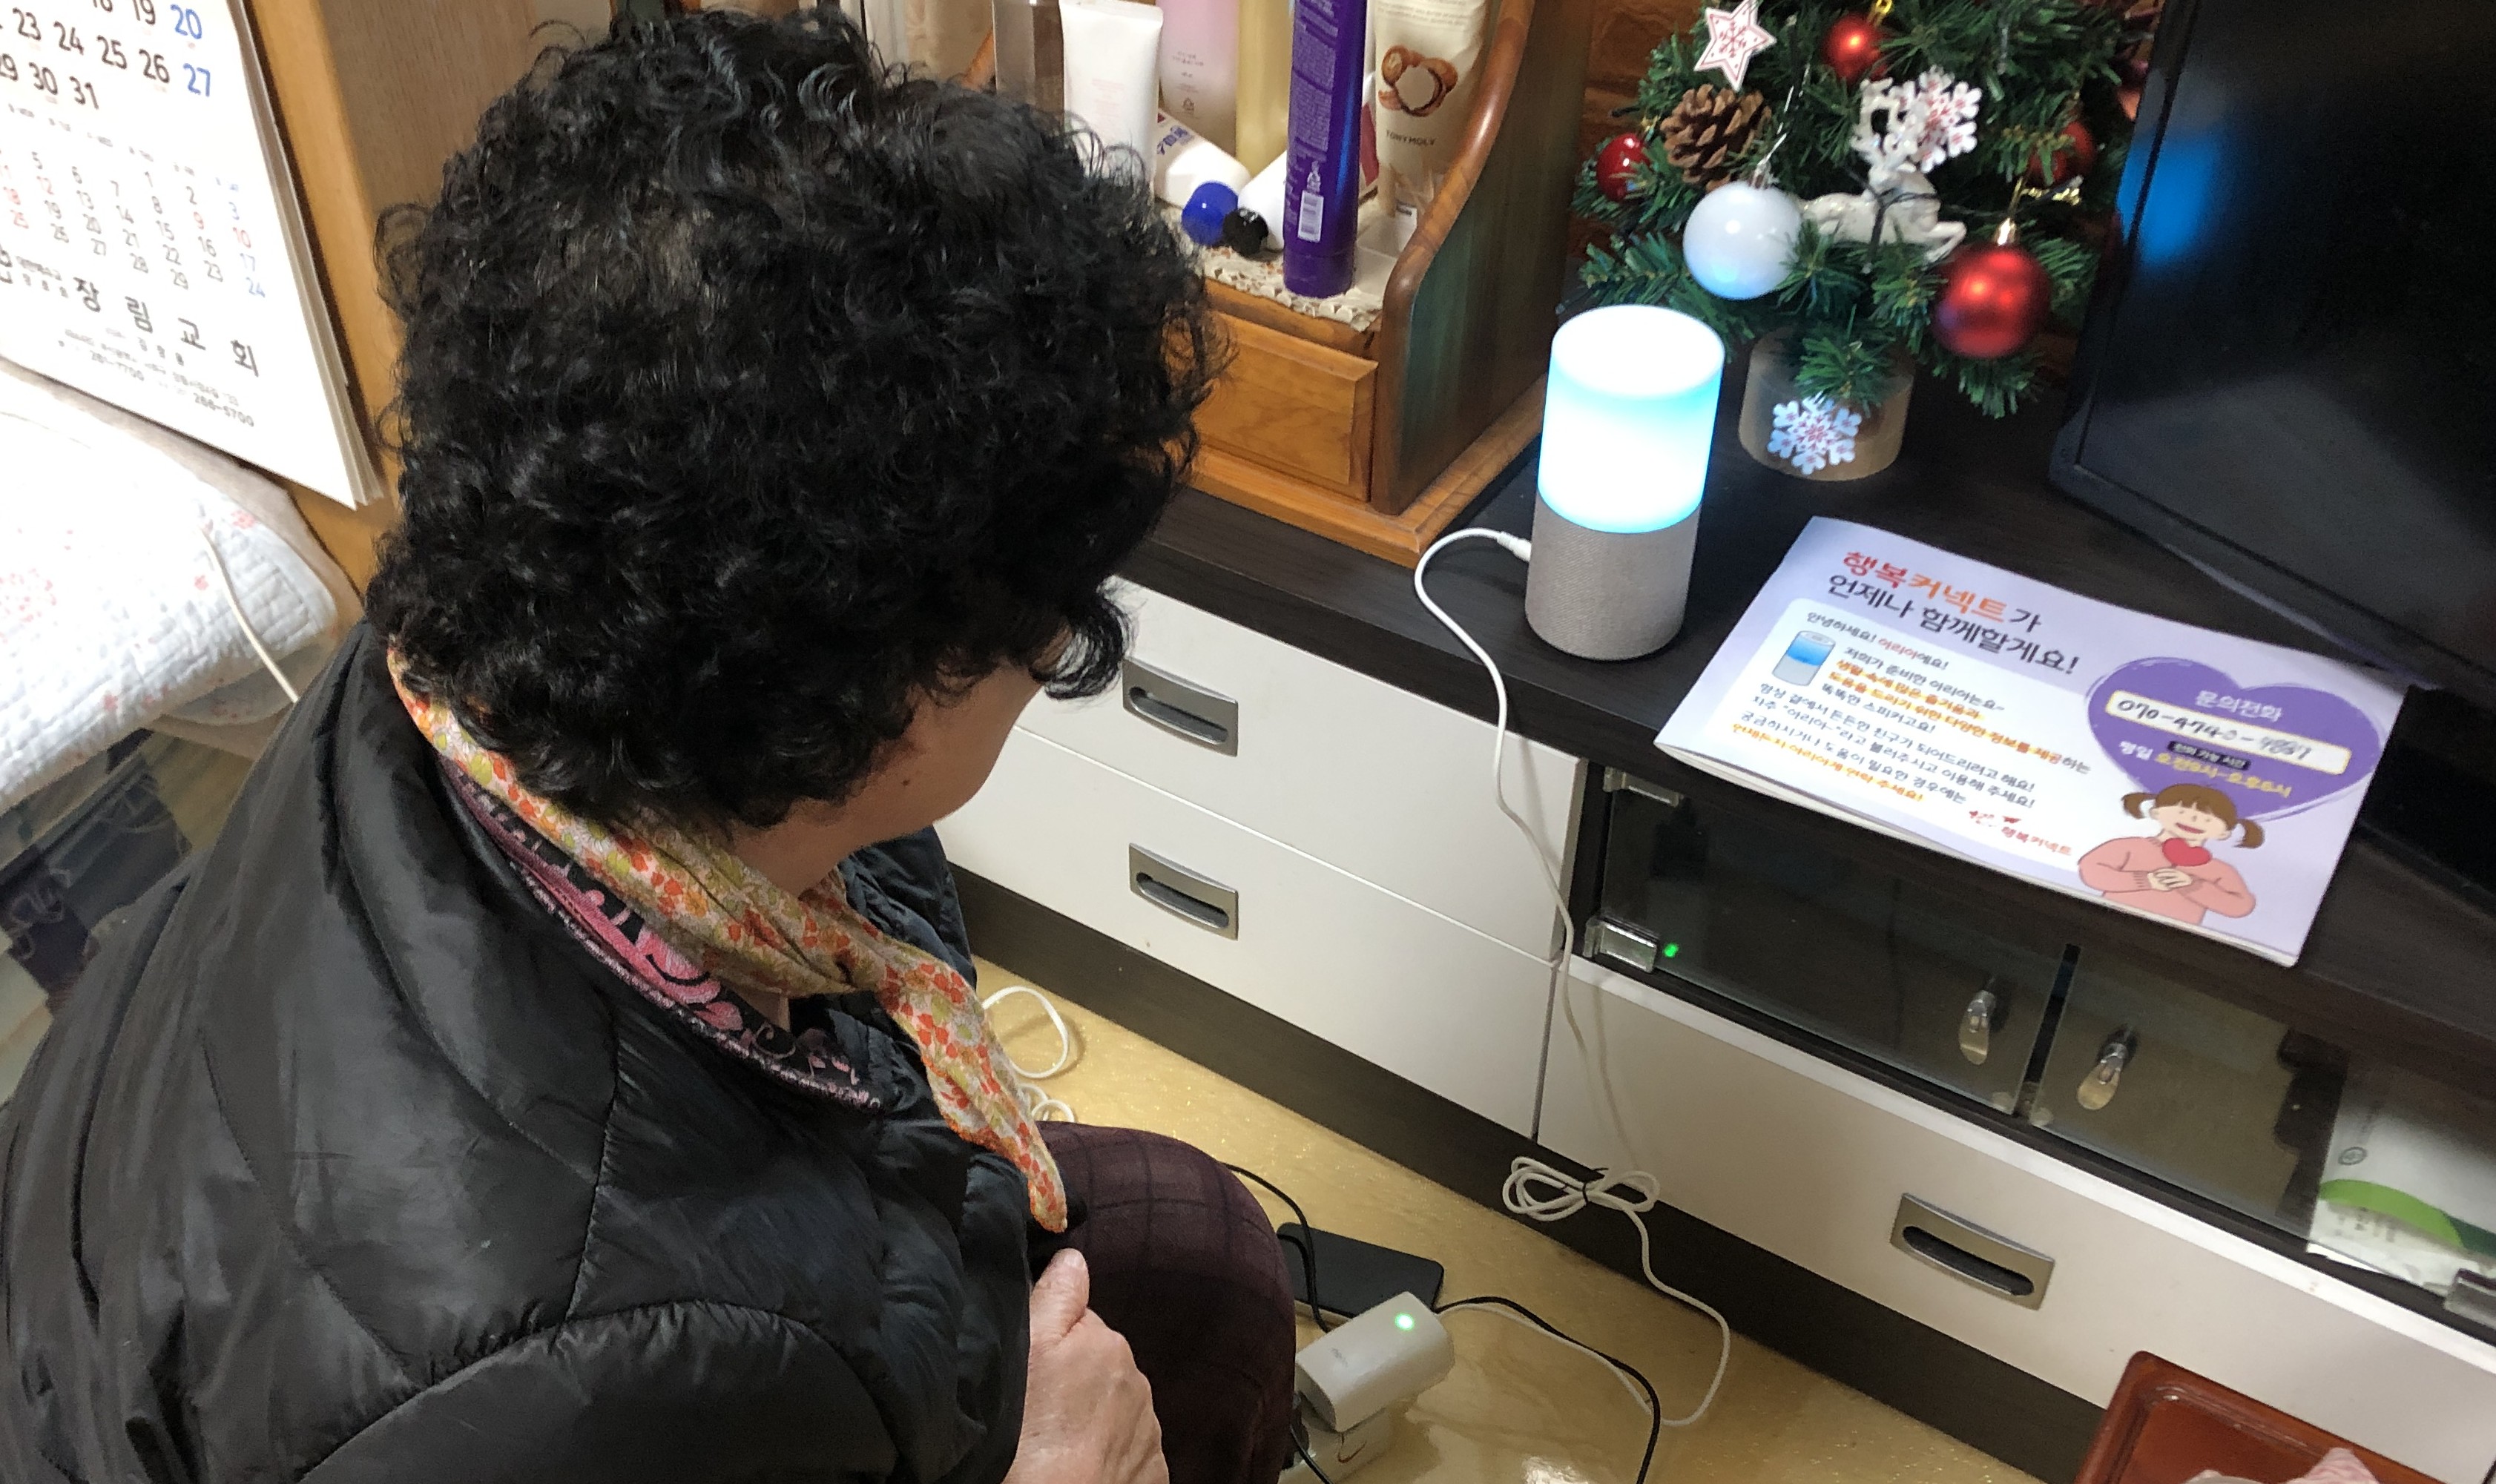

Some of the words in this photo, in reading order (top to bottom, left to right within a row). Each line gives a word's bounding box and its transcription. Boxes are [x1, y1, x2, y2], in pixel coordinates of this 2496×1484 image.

[132, 0, 156, 25] 19
[171, 4, 202, 39] 20
[13, 7, 41, 41] 23
[53, 21, 84, 56] 24
[96, 35, 127, 70] 25
[139, 49, 170, 83] 26
[183, 63, 211, 96] 27
[29, 62, 58, 95] 30
[70, 76, 99, 110] 31
[32, 151, 42, 169] 5
[72, 166, 82, 184] 6
[111, 180, 119, 197] 7
[152, 196, 162, 214] 8
[194, 211, 204, 230] 9
[233, 227, 251, 248] 10
[145, 171, 153, 187] 1
[186, 186, 197, 205] 2
[228, 202, 240, 220] 3
[116, 205, 134, 224] 14
[156, 220, 174, 241] 15
[198, 236, 217, 257] 16
[240, 253, 255, 272] 17
[162, 244, 182, 266] 22
[203, 260, 223, 283] 23
[246, 277, 266, 298] 24
[1843, 550, 2043, 634] 행복커넥트가
[1808, 612, 1877, 644] 안녕하세요!
[1828, 573, 1914, 619] 언제나
[1920, 607, 2080, 675] 함께할게요!
[1844, 646, 1884, 669] 저희가
[1886, 664, 1927, 687] 준비한
[1822, 683, 1861, 706] 똑똑한
[1863, 702, 1936, 734] 스피커고요!
[1871, 688, 1912, 710] 드리기
[1914, 706, 1942, 721] 위한
[1945, 716, 1986, 738] 다양한
[1991, 732, 2030, 753] 정보를
[2035, 748, 2092, 774] 제공하는
[2196, 690, 2283, 722] 문의전화
[1742, 710, 1821, 746] 궁금하시거나
[1824, 742, 1866, 765] 도움이
[1868, 759, 1909, 781] 필요한
[1913, 776, 1966, 805] 경우에는
[1752, 696, 1777, 710] 자주
[1870, 742, 1938, 774] 불러주시고
[1942, 770, 1986, 791] 이용해
[1988, 785, 2035, 808] 주세요!
[1760, 683, 1787, 699] 항상
[1830, 710, 1871, 732] 든든한
[1874, 728, 1914, 748] 친구가
[2001, 774, 2035, 793] 해요!
[2119, 740, 2153, 761] 평일
[1877, 779, 1923, 801] 주세요!
